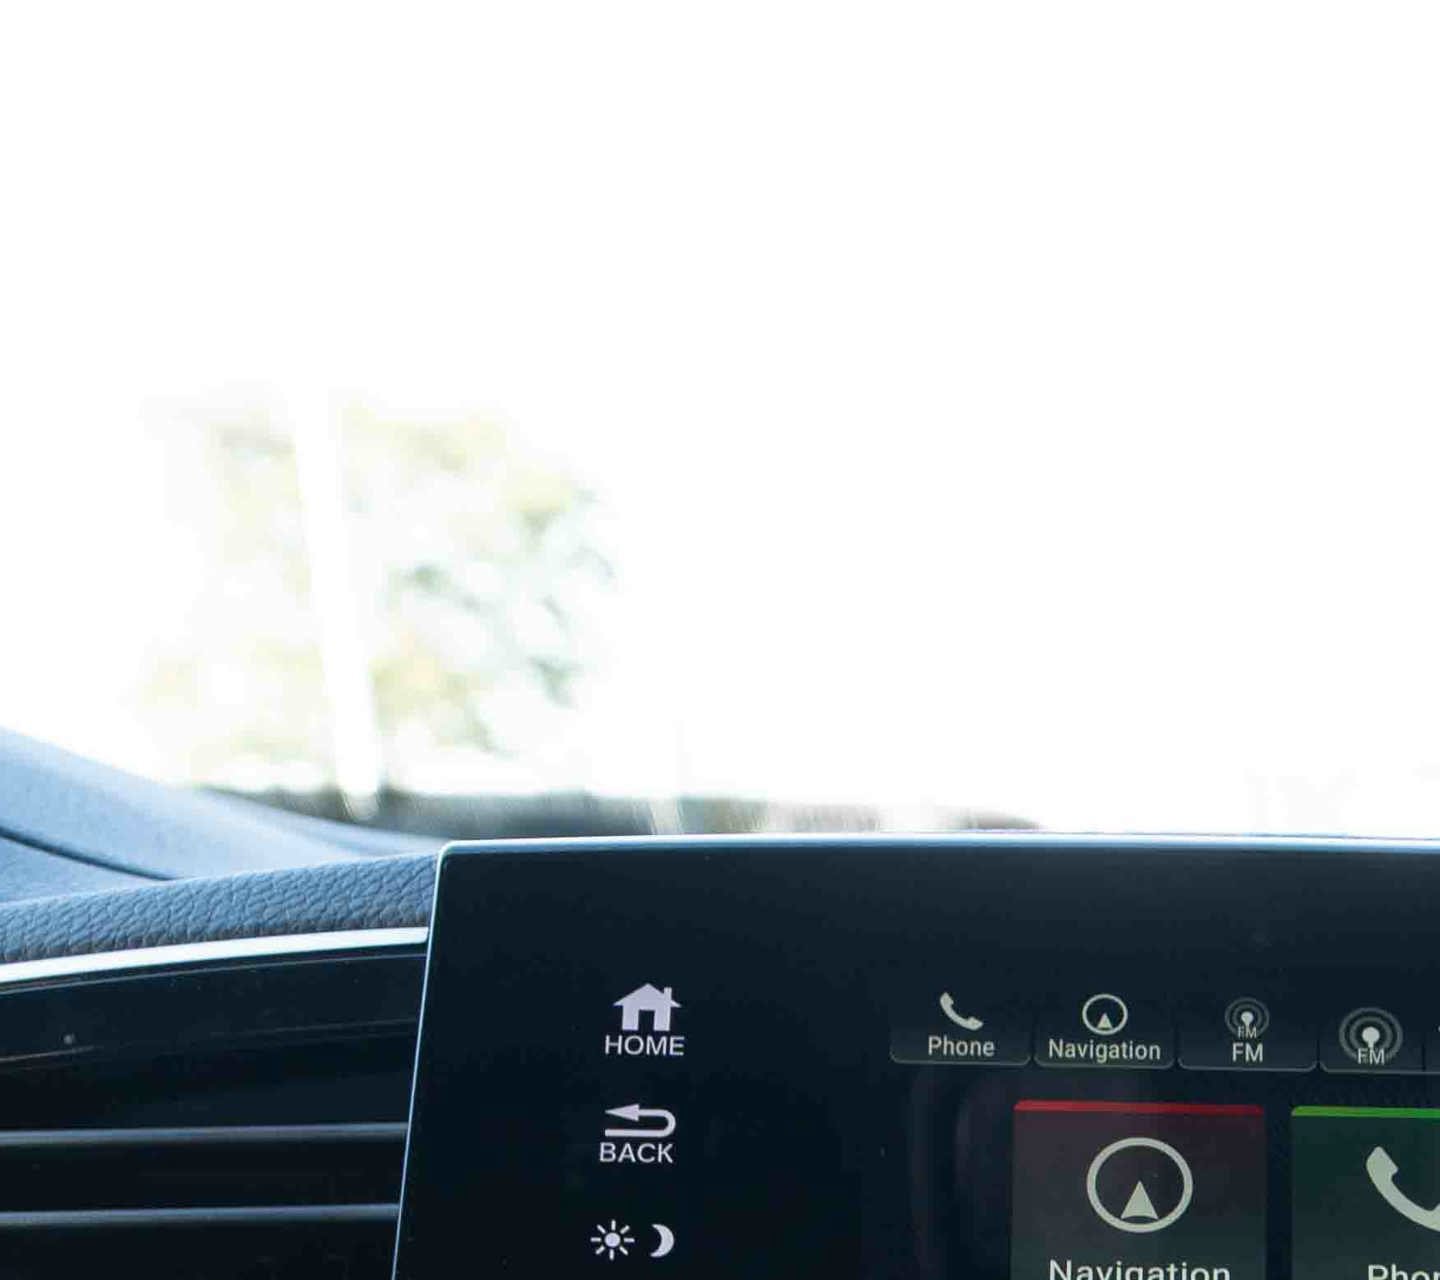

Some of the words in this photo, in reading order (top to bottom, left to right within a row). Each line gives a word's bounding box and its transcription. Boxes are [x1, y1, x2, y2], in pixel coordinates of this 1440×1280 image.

[1237, 1026, 1257, 1039] FM
[605, 1036, 685, 1055] HOME
[927, 1037, 994, 1058] Phone
[1048, 1038, 1161, 1062] Navigation
[1231, 1042, 1264, 1061] FM
[1357, 1047, 1386, 1064] FM
[599, 1143, 673, 1163] BACK
